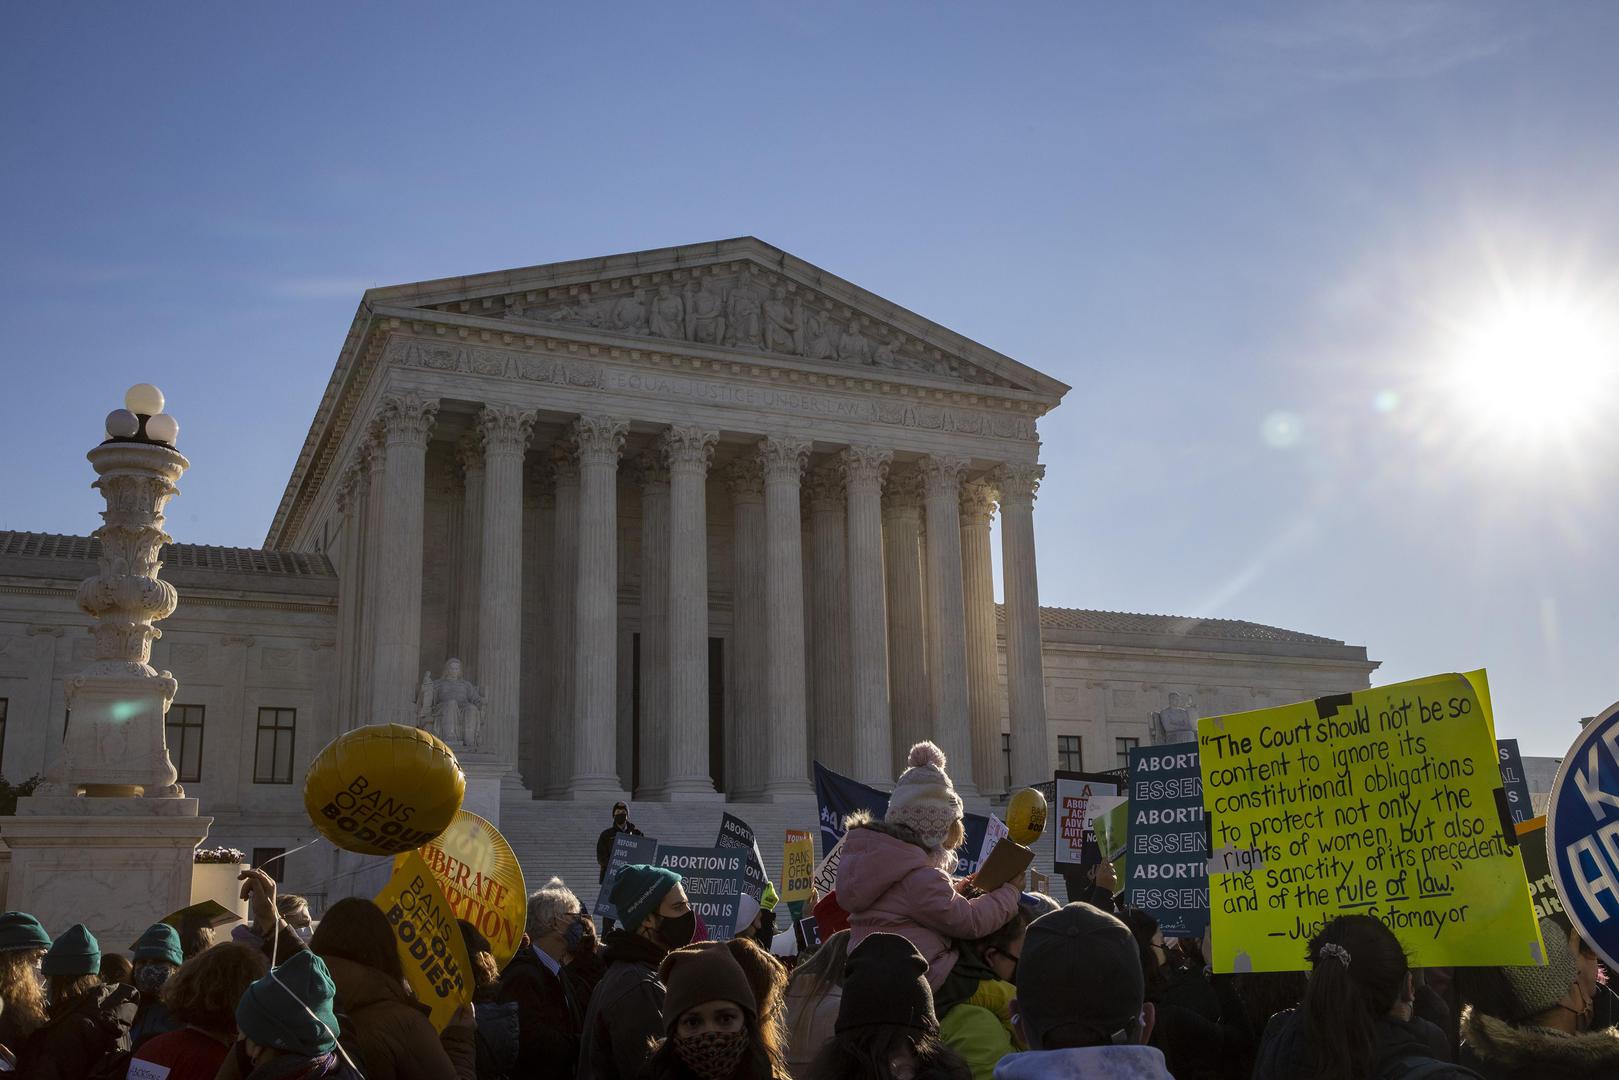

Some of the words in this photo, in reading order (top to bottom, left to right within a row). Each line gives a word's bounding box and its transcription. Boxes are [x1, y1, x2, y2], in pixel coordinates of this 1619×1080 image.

[617, 374, 681, 394] EQUAL
[688, 381, 754, 402] JUSTICE
[763, 391, 821, 410] UNDER
[827, 399, 860, 415] LAW
[1259, 718, 1312, 748] Court
[1316, 705, 1371, 743] should
[1379, 699, 1411, 732] not
[1418, 696, 1444, 724] be
[1449, 697, 1472, 719] so
[1209, 751, 1291, 788] content
[1297, 747, 1320, 773] to
[1330, 740, 1389, 778] ignore
[1397, 730, 1427, 758] its
[1214, 769, 1353, 815] constitutional
[1364, 757, 1475, 799] obligations
[335, 791, 384, 823] OFF
[348, 775, 415, 822] BANS
[1218, 820, 1241, 844] to
[1250, 805, 1324, 847] protect
[1335, 798, 1370, 826] not
[1378, 791, 1421, 833] only
[1430, 784, 1473, 812] the
[661, 855, 727, 870] ABORTION
[729, 857, 740, 870] IS
[1219, 873, 1255, 894] the
[1266, 855, 1354, 889] sanctity
[1366, 845, 1386, 871] of
[1389, 845, 1416, 869] its
[1421, 830, 1514, 878] precedents
[1223, 841, 1282, 875] rights
[1289, 832, 1310, 857] of
[1318, 826, 1392, 854] women,
[1400, 814, 1435, 843] but
[1444, 812, 1485, 839] also
[410, 874, 451, 942] BANS
[721, 903, 733, 917] IS
[1223, 889, 1258, 914] and
[1268, 887, 1290, 909] of
[1294, 883, 1329, 908] the
[1336, 875, 1377, 903] rule
[1386, 869, 1407, 897] of
[388, 902, 455, 998] BODIES
[400, 889, 434, 934] OFF
[431, 936, 463, 993] OUR
